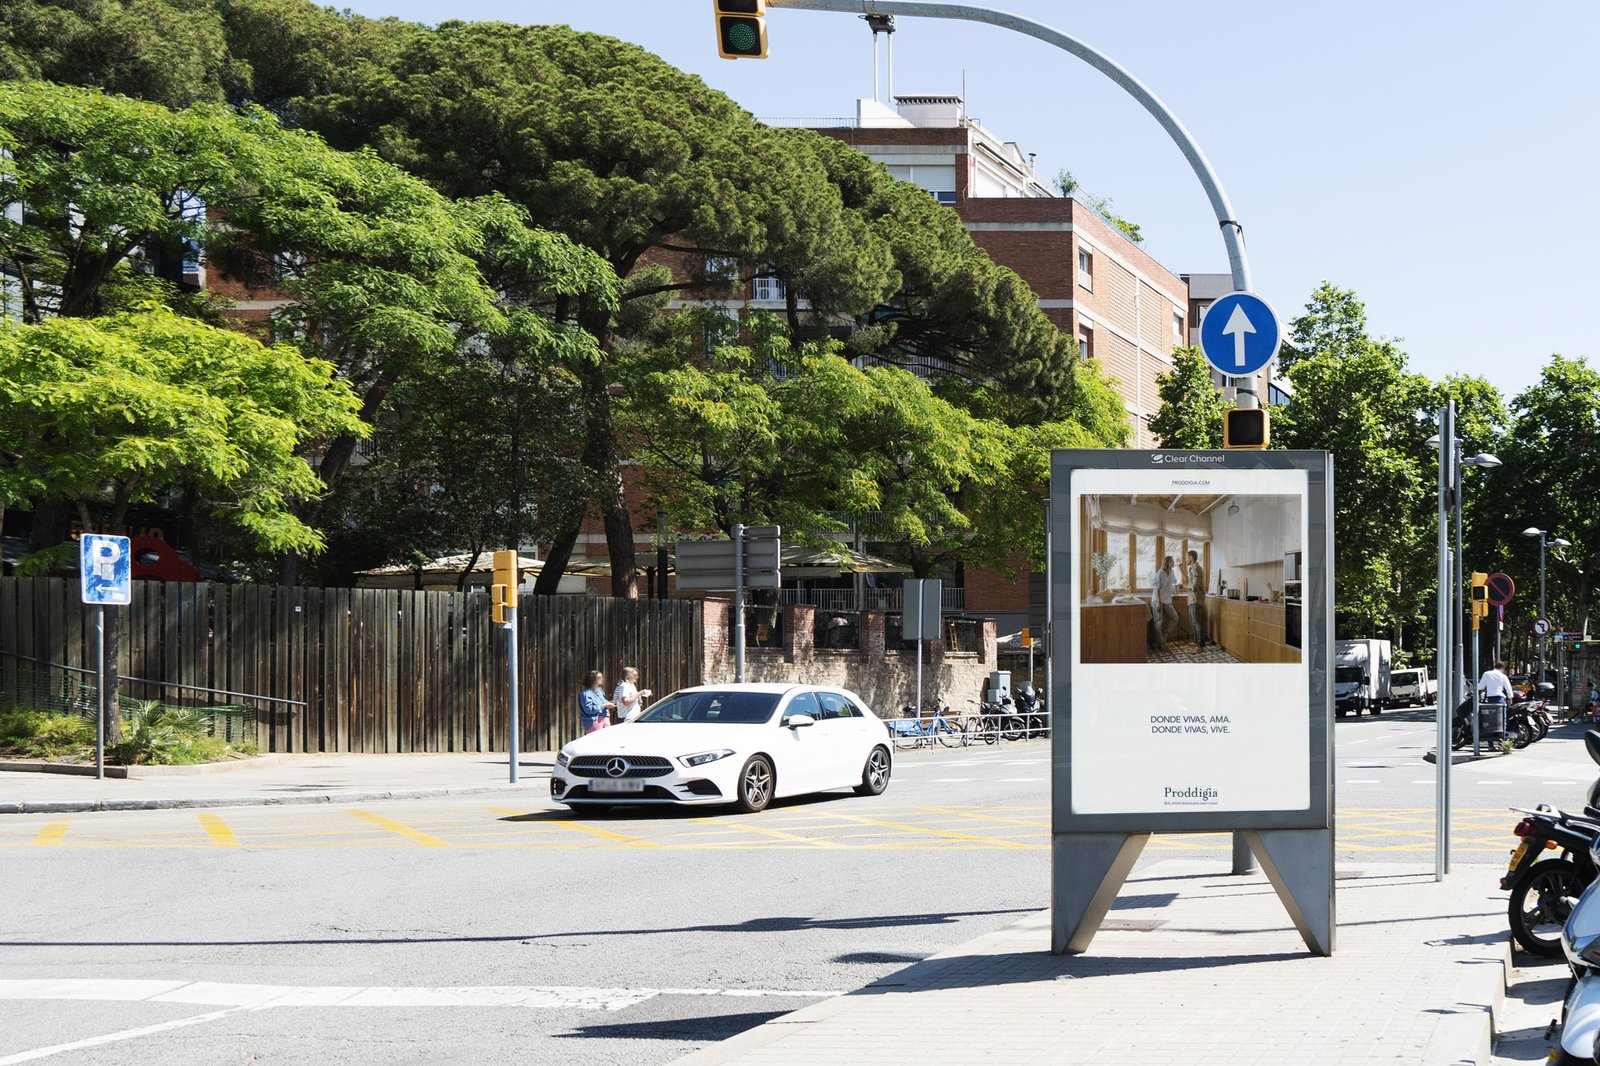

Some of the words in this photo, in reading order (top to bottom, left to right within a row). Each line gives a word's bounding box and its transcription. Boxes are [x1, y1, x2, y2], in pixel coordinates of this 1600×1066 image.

[1164, 455, 1188, 463] Clear
[1189, 454, 1225, 463] Channel
[92, 540, 121, 576] P
[1183, 716, 1207, 724] VIVAS,
[1184, 726, 1208, 734] VIVAS,
[1164, 787, 1218, 801] Proddigia
